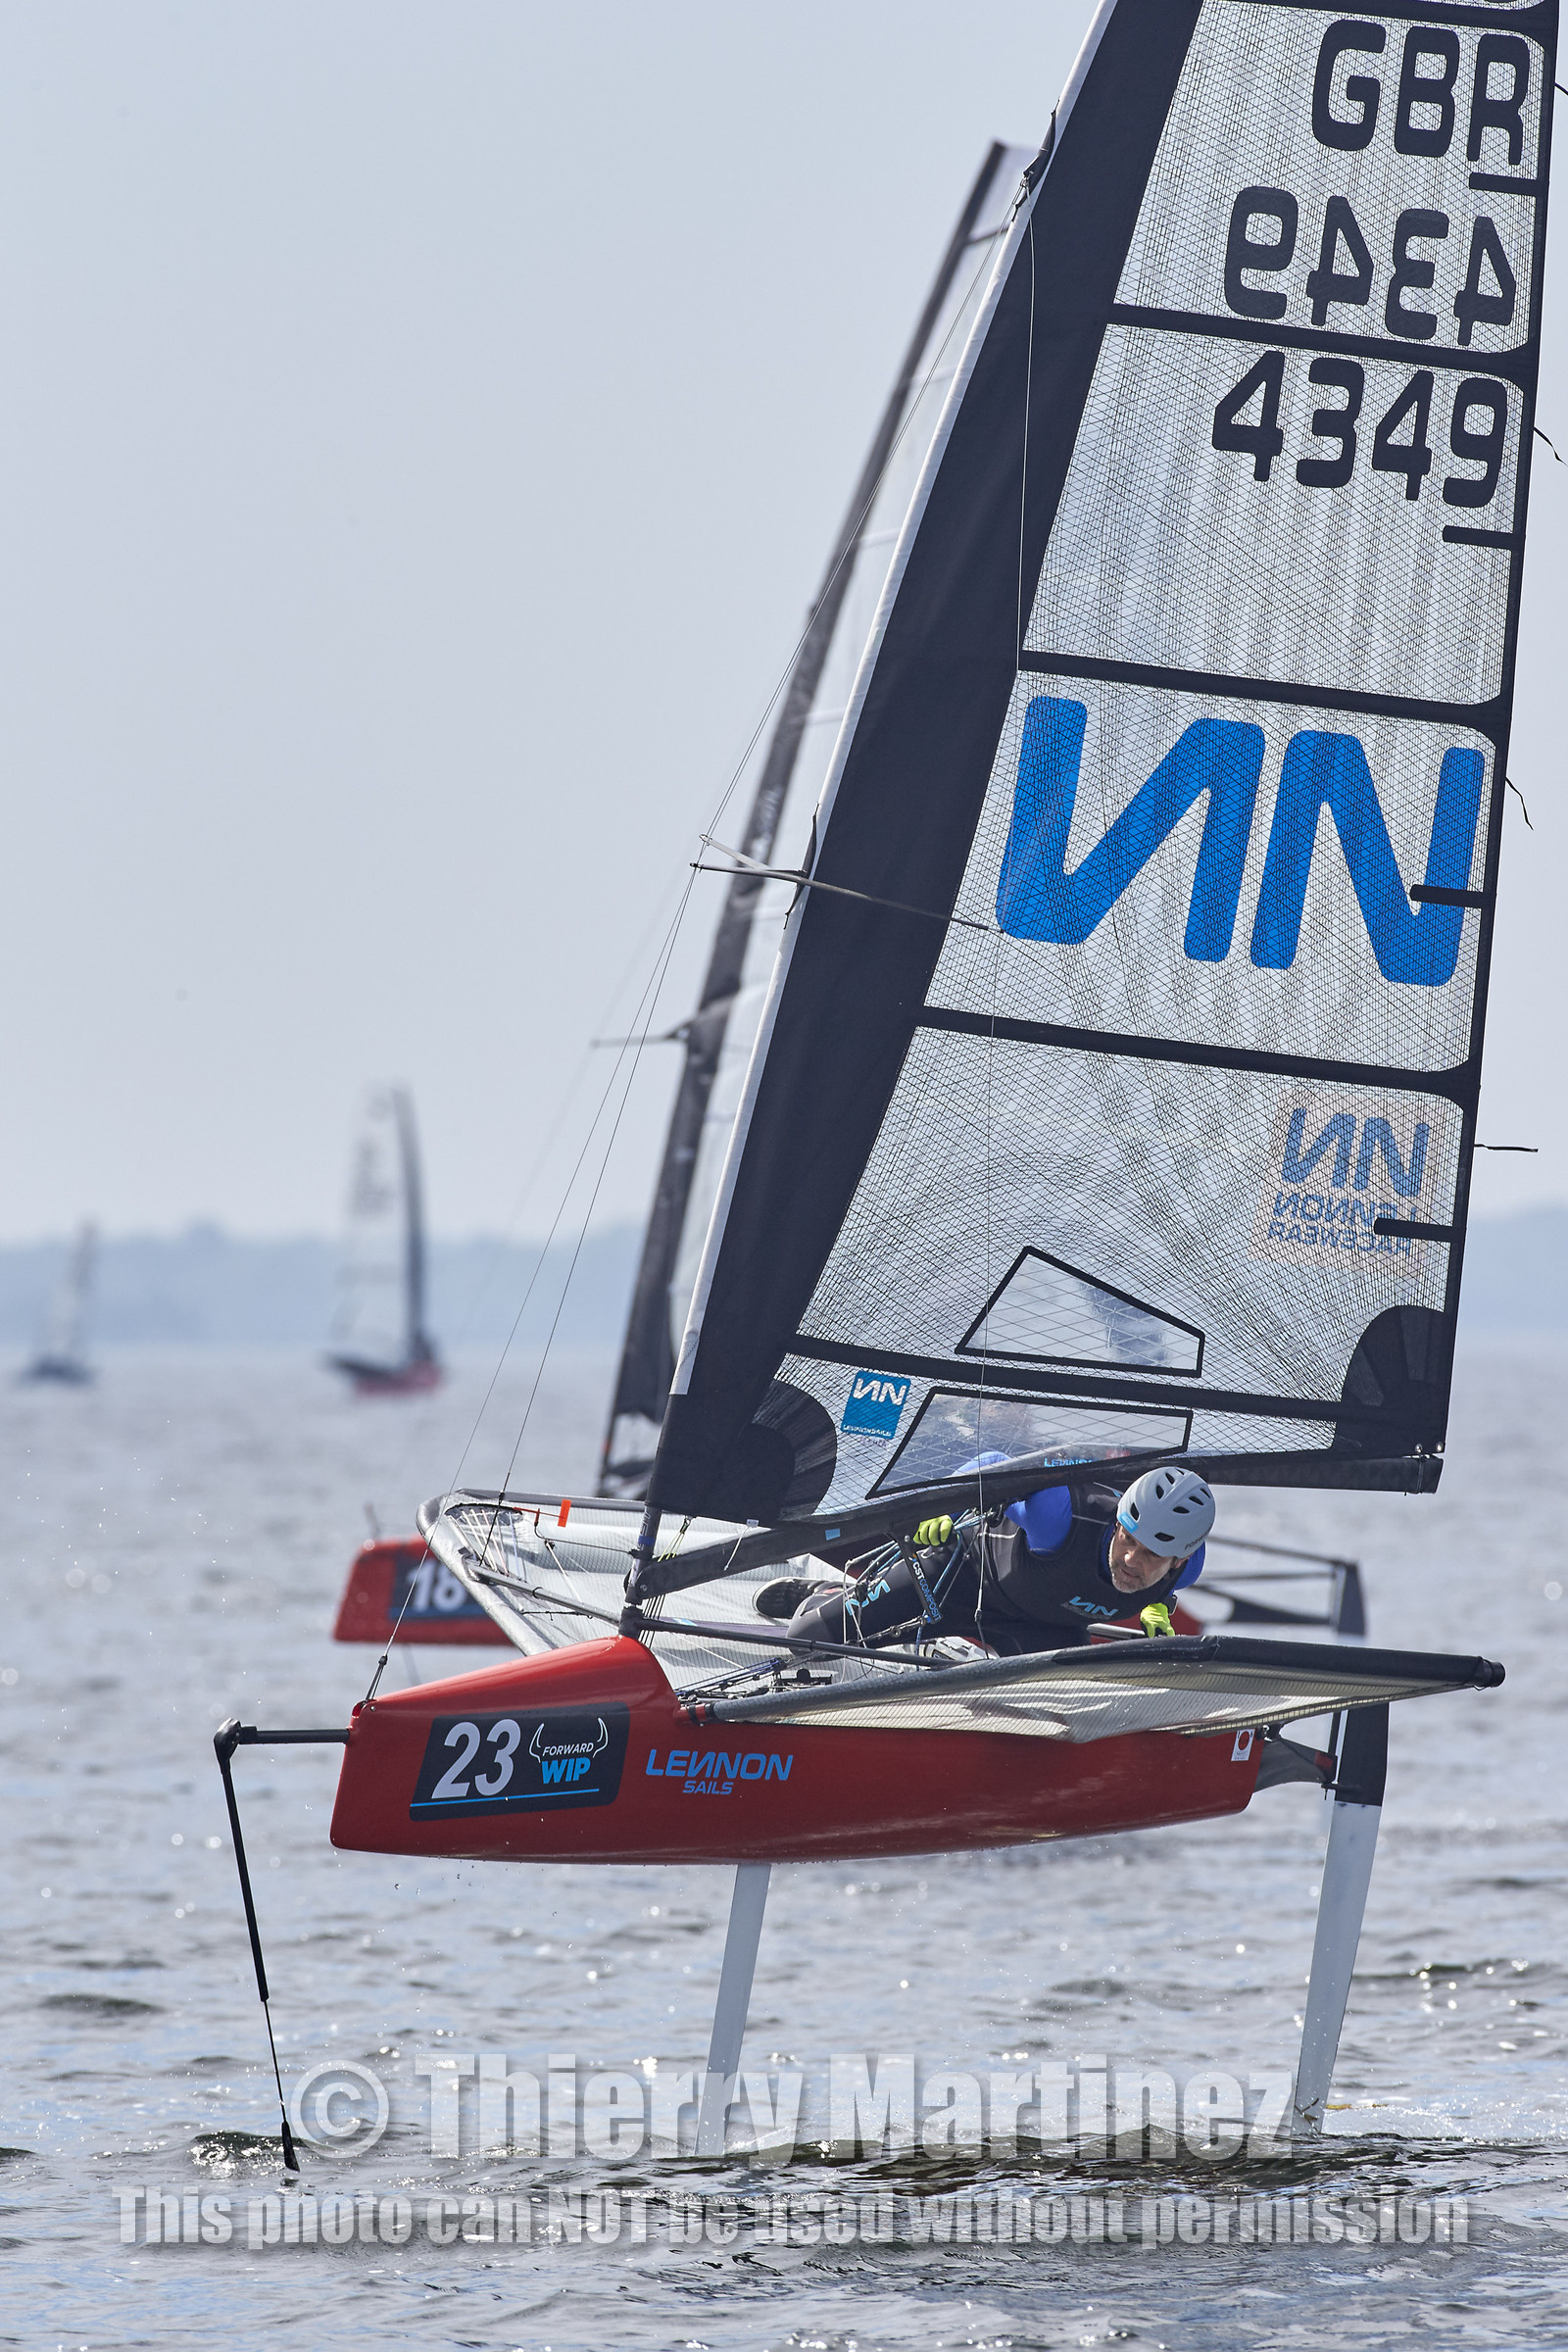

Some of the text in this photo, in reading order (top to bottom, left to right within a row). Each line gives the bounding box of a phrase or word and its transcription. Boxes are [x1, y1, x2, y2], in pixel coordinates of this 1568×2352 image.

[1311, 20, 1530, 165] GBR
[1211, 350, 1507, 508] 4349
[431, 1719, 521, 1799] 23
[542, 1742, 594, 1757] FORWARD
[645, 1749, 794, 1781] LENNON
[541, 1757, 591, 1785] WIP
[682, 1781, 734, 1795] SAILS
